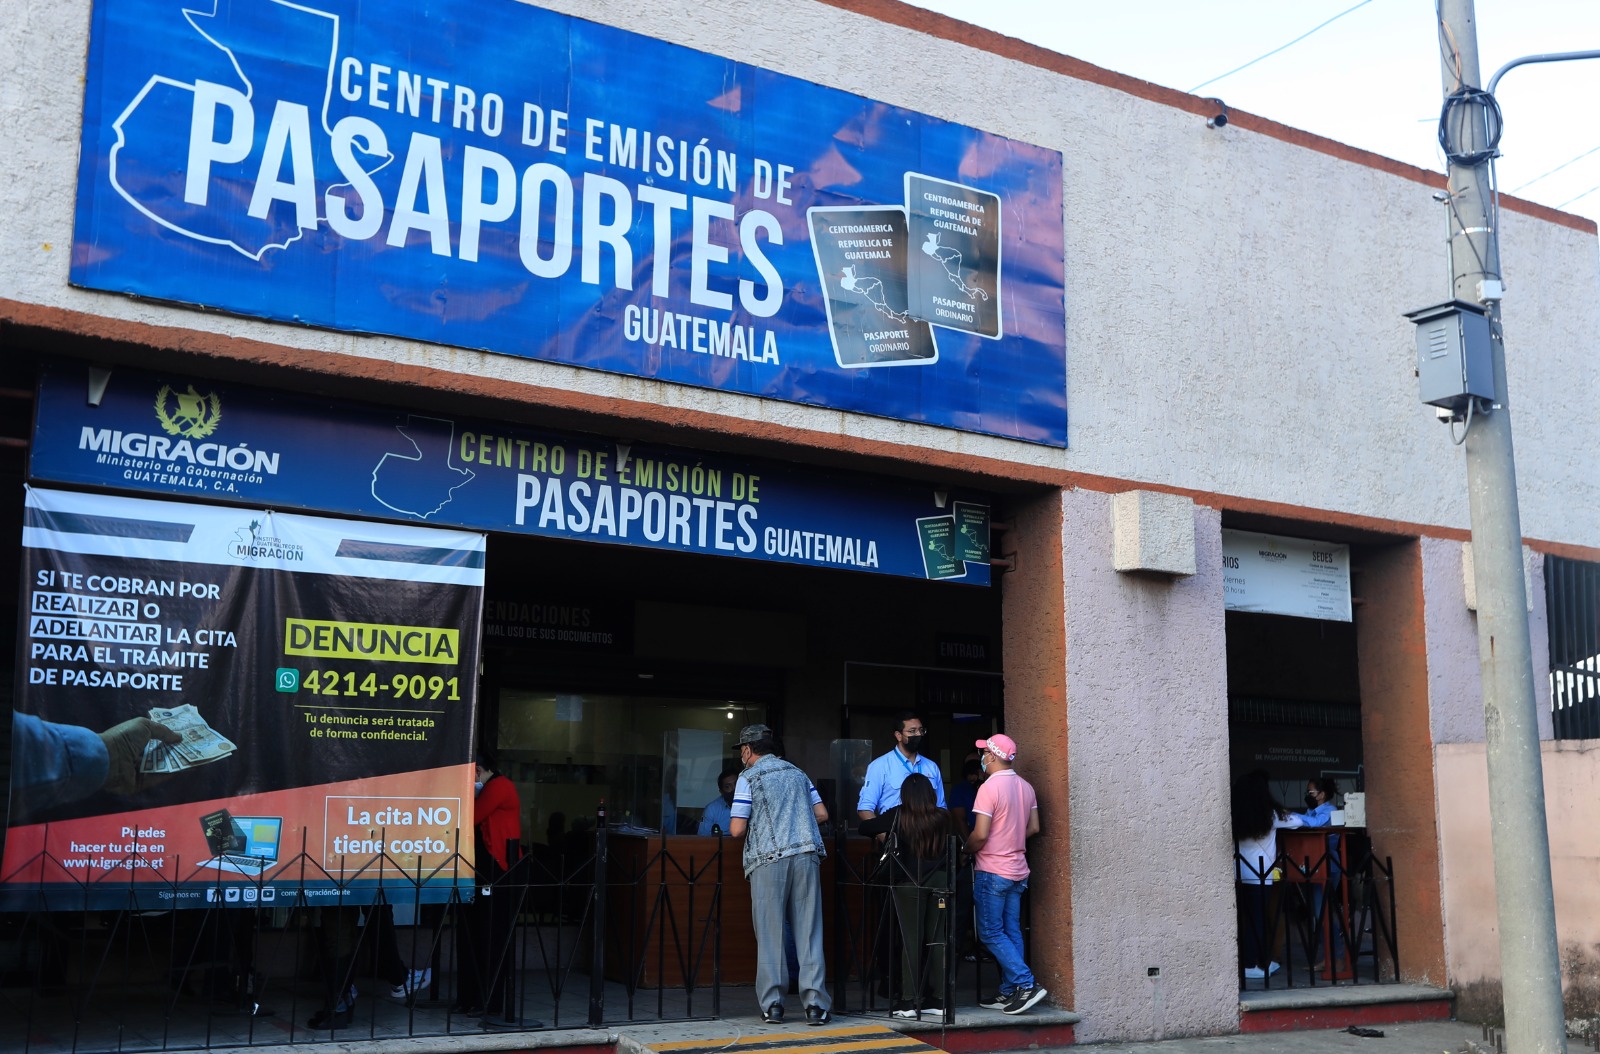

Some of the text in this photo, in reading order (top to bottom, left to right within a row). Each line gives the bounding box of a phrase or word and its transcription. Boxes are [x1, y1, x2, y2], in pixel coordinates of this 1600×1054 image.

[340, 56, 794, 206] CENTRO DE EMISIÓN DE
[184, 79, 784, 318] PASAPORTES
[924, 192, 985, 214] CENTROAMERICA
[930, 207, 982, 226] REPUBLICA DE
[828, 224, 894, 234] CENTROAMERICA
[933, 219, 978, 237] GUATEMALA
[838, 238, 893, 248] REPUBLICA DE
[844, 250, 892, 260] GUATEMALA
[932, 296, 976, 313] PASAPORTE
[935, 308, 973, 323] ORDINARIO
[624, 304, 779, 365] GUATEMALA
[864, 330, 910, 340] PASAPORTE
[869, 342, 910, 352] ORDINARIO
[78, 426, 280, 475] MIGRACIÓN
[96, 453, 263, 484] Ministerio de Gobernación
[460, 431, 760, 503] CENTRO DE EMISIÓN DE
[124, 469, 239, 493] GUATEMALA, C.A.
[515, 473, 879, 568] PASAPORTES GUATEMALA
[1312, 550, 1333, 564] SEDES
[36, 570, 220, 600] SI TE COBRAN POR
[1230, 586, 1246, 594] horas
[35, 594, 160, 619] REALIZAR O
[486, 599, 591, 628] ENDACIONES
[32, 619, 238, 648] ADELANTAR LA CITA
[290, 624, 454, 658] DENUNCIA
[486, 624, 613, 645] MAL USO DE SUS DOCUMENTOS
[31, 642, 210, 669] PARA EL TRÁMITE
[940, 642, 985, 660] ENTRADA
[30, 667, 183, 691] DE PASAPORTE
[302, 670, 462, 701] 4214-9091
[304, 712, 435, 728] Tu denuncia será tratada
[309, 728, 428, 742] de forma confidencial.
[348, 806, 452, 826] La cita NO
[70, 841, 165, 853] hacer tu cita en
[333, 834, 450, 854] tiene costo.
[158, 890, 189, 900] Sígunos
[304, 889, 351, 898] igraciónGute
